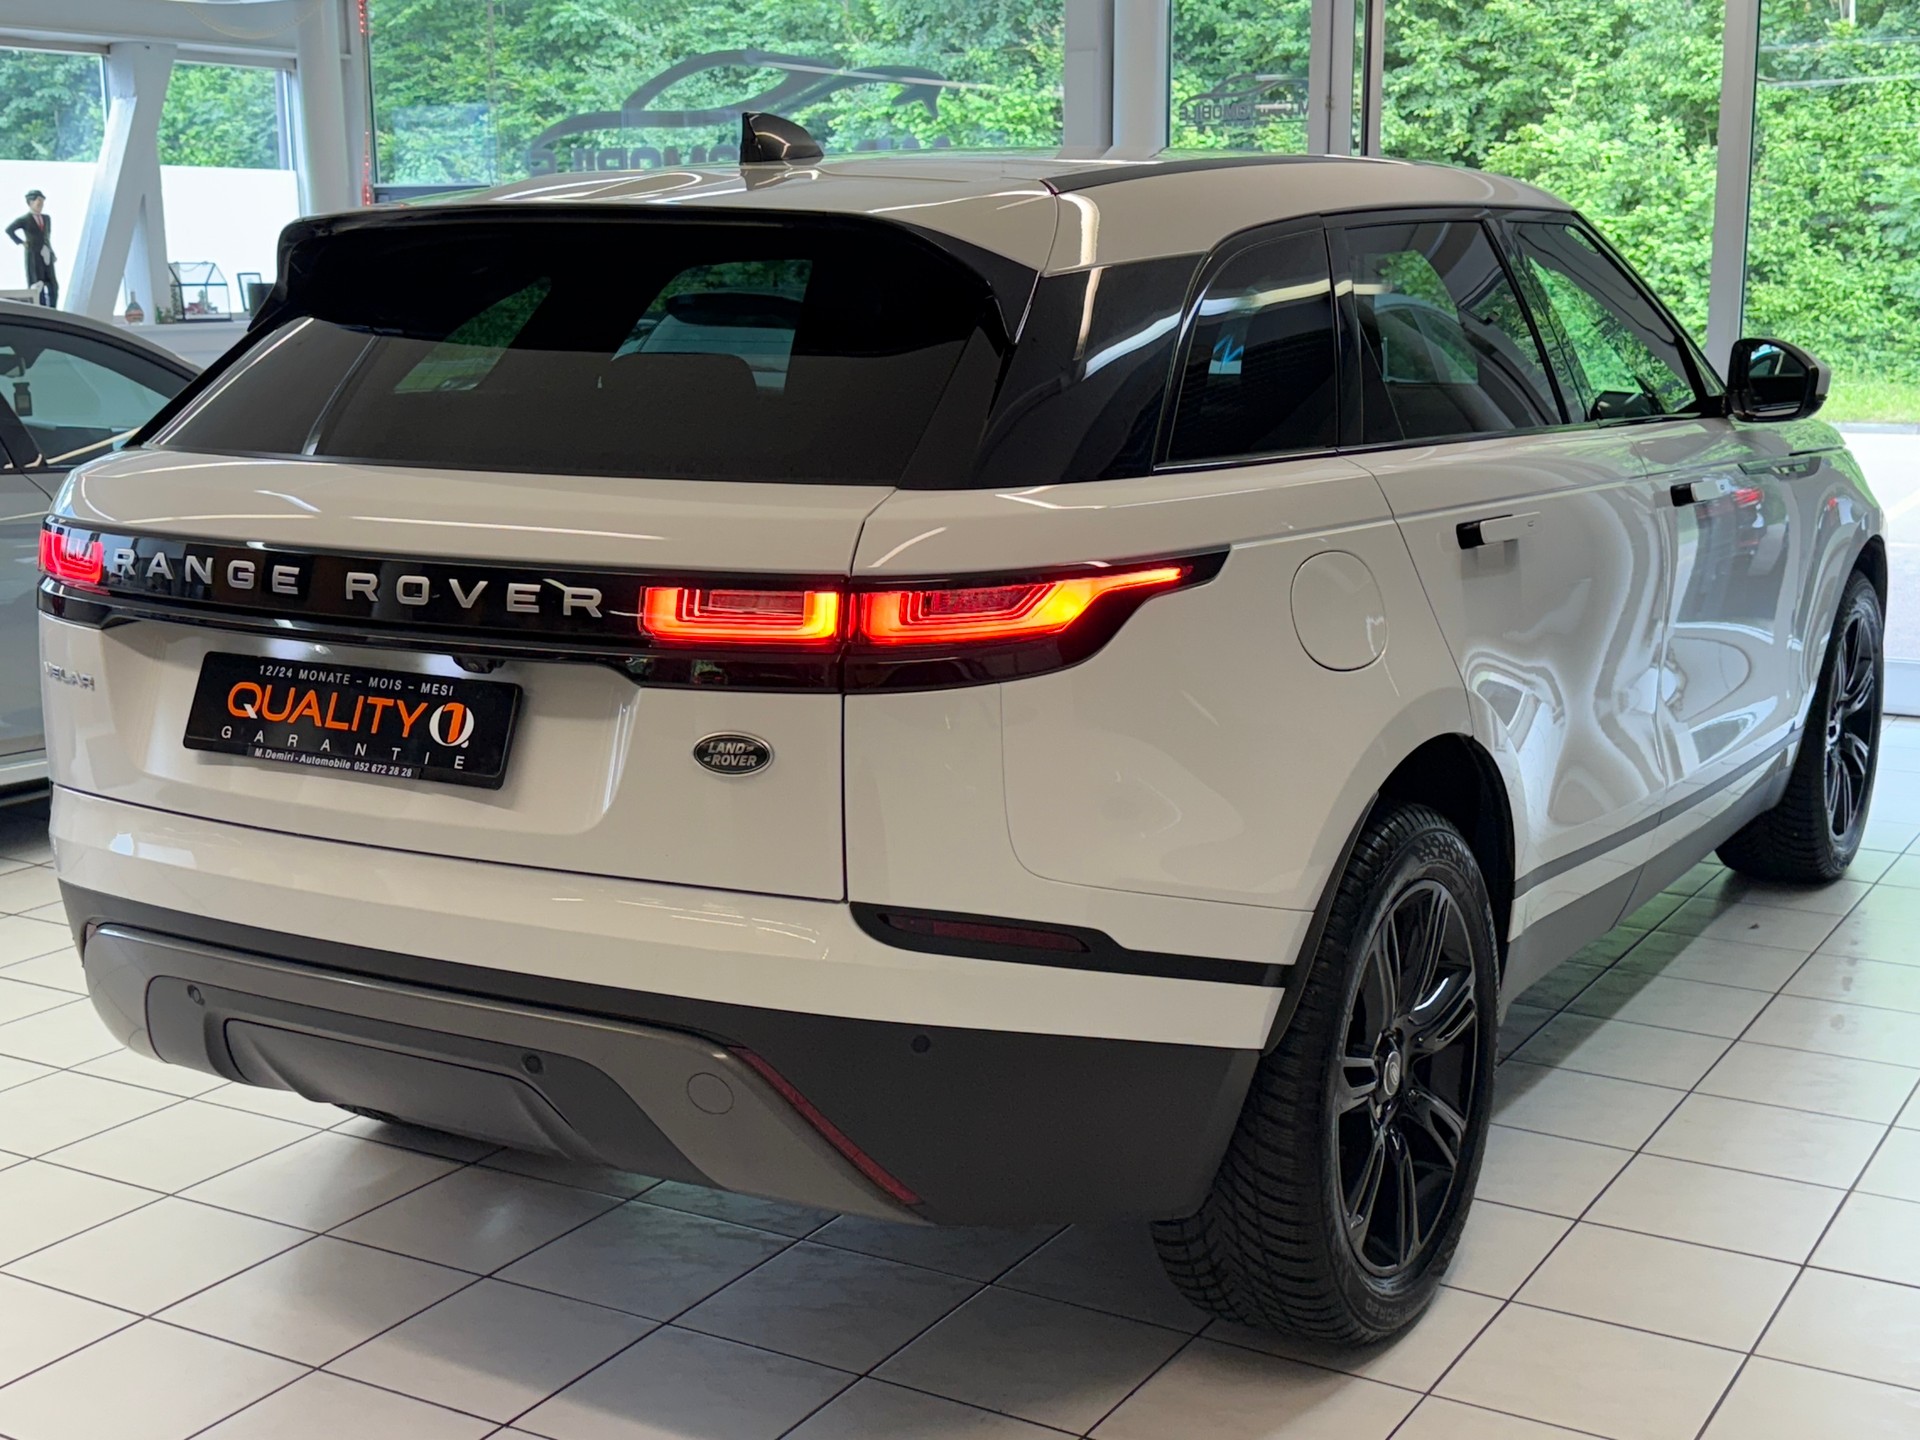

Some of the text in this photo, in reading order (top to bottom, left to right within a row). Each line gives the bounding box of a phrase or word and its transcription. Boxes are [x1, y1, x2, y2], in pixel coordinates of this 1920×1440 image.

[113, 548, 603, 618] RANGE ROVER
[259, 665, 293, 678] 12/24
[298, 669, 351, 685] MONATE
[368, 677, 402, 691] MOIS
[420, 683, 454, 696] MESI
[227, 681, 429, 738] QUALITY
[221, 726, 465, 769] GARANTIE
[707, 742, 746, 754] LAND
[711, 754, 757, 767] ROVER
[299, 754, 351, 769] Automobile
[354, 761, 369, 771] 052
[371, 763, 387, 774] 672
[388, 766, 399, 776] 28
[401, 767, 412, 777] 28
